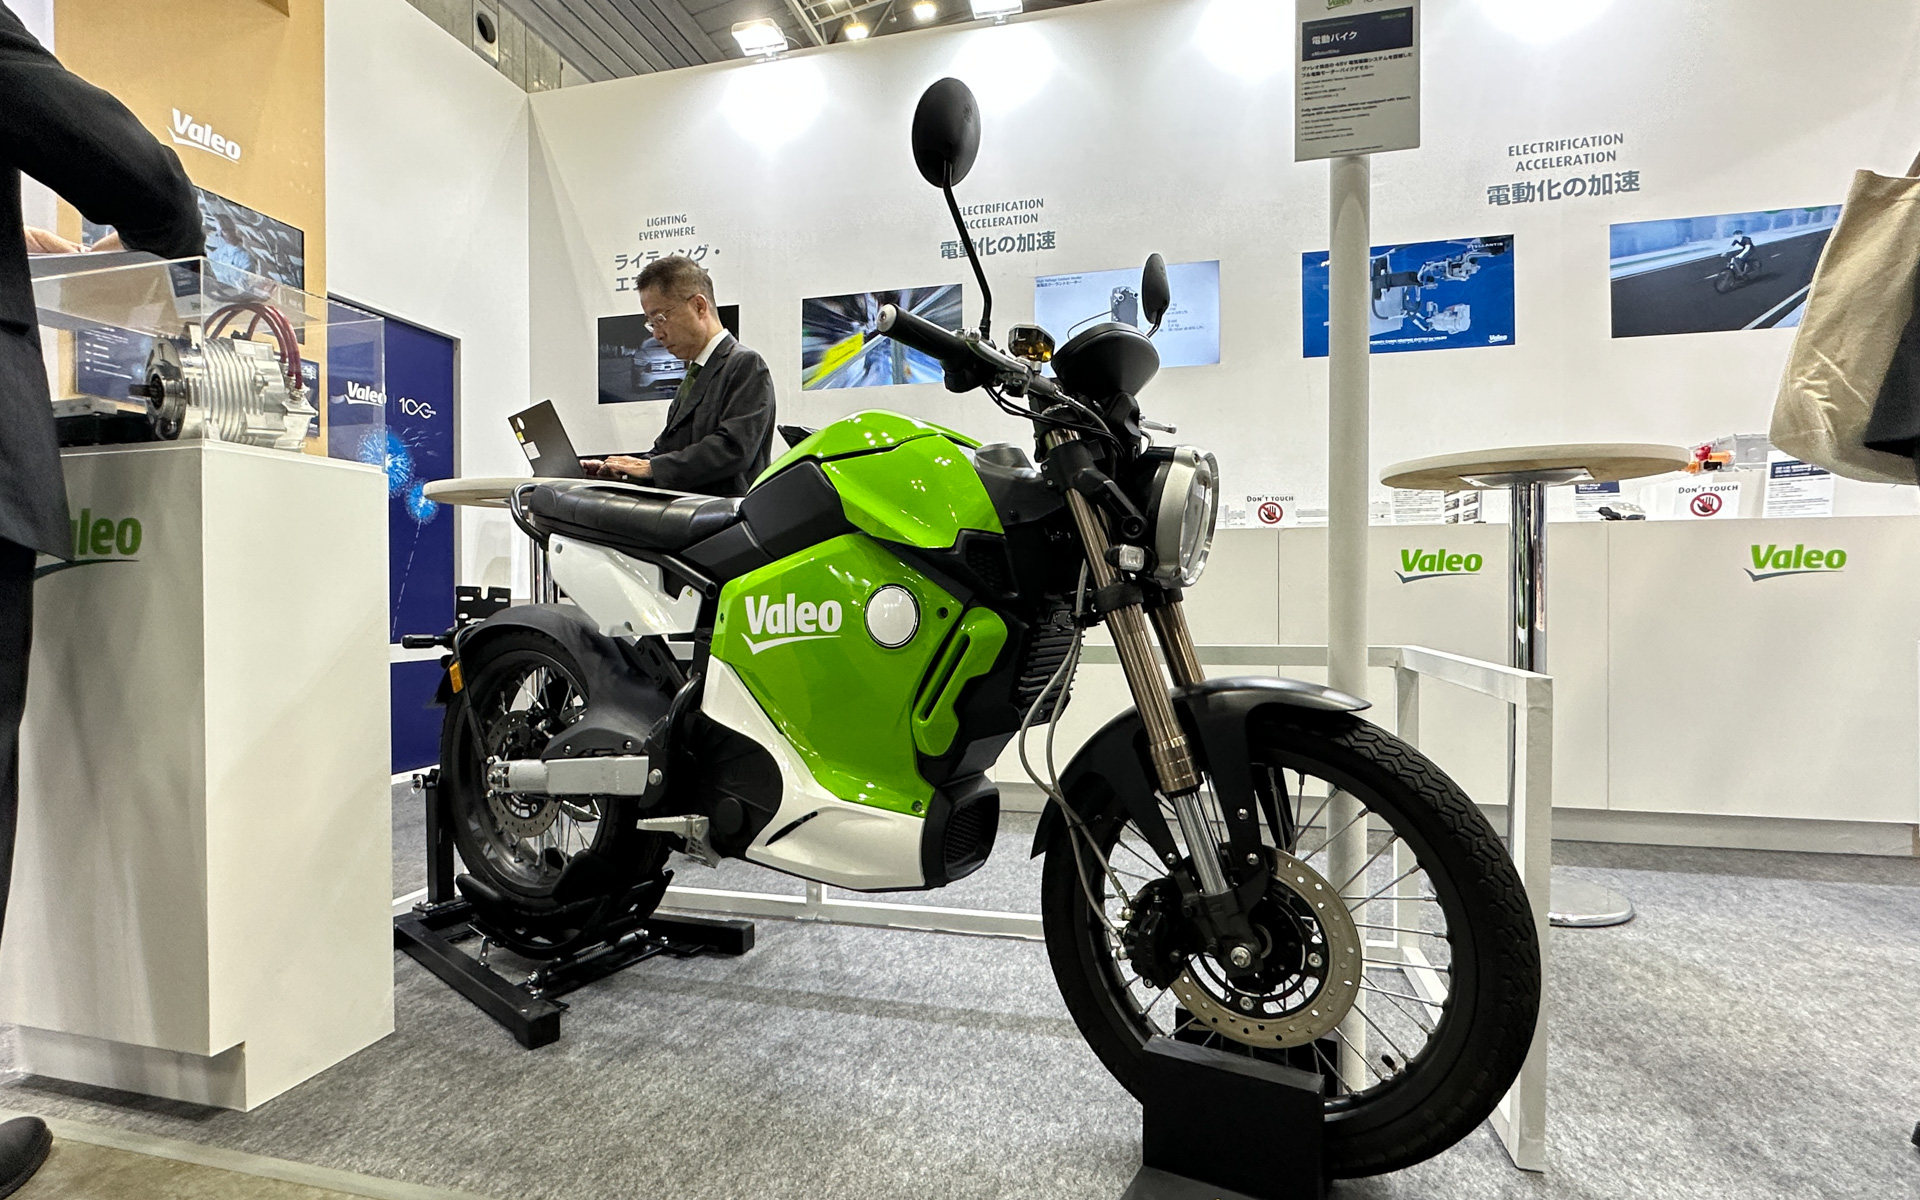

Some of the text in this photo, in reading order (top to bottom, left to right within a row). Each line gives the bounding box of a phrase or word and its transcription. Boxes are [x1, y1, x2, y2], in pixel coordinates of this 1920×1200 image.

[172, 107, 242, 160] Valeo
[1508, 133, 1624, 157] ELECTRIFICATION
[1515, 150, 1617, 172] ACCELERATION
[1486, 170, 1641, 206] 電動化の加速
[646, 214, 687, 227] LIGHTING
[638, 226, 696, 241] EVERYWHERE
[347, 380, 387, 404] Valeo
[1246, 494, 1268, 503] DON'T
[1678, 484, 1739, 494] DON'T TOUCH
[71, 508, 142, 555] leo
[1401, 549, 1483, 572] Valeo
[1751, 544, 1847, 569] Valeo
[744, 593, 843, 635] Valeo
